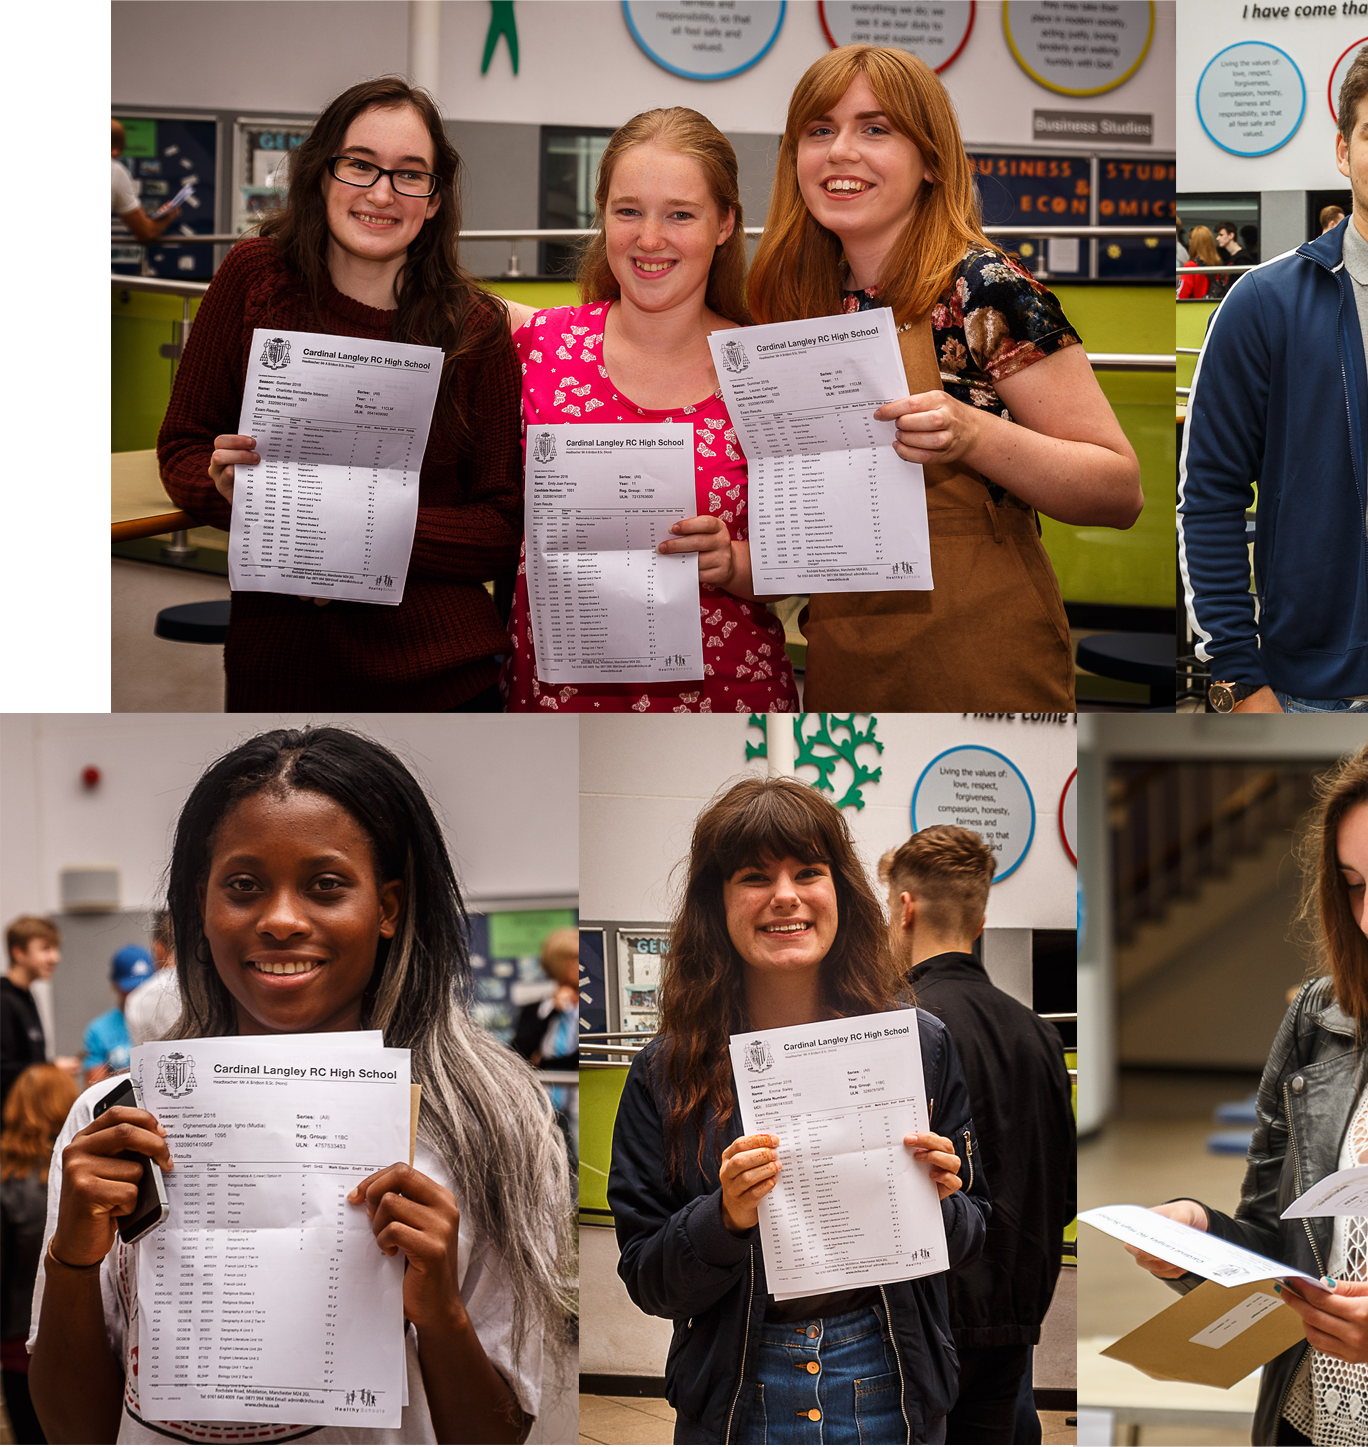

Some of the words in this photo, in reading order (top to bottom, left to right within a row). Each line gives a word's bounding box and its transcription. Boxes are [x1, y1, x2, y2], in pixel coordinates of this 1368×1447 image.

[1242, 5, 1248, 19] I
[1252, 4, 1290, 18] have
[1294, 5, 1337, 17] come
[1034, 116, 1097, 134] Business
[1100, 118, 1152, 136] Studies
[1075, 178, 1090, 196] &
[756, 341, 787, 352] Cardinal
[787, 338, 817, 348] Langley
[817, 334, 830, 343] RC
[831, 332, 850, 341] High
[850, 327, 879, 338] School
[303, 348, 337, 359] Cardinal
[338, 352, 369, 364] Langley
[370, 356, 383, 364] RC
[384, 357, 403, 367] High
[403, 359, 431, 370] School
[566, 439, 595, 447] Cardinal
[596, 439, 624, 448] Langley
[625, 439, 637, 447] RC
[639, 439, 657, 448] High
[1021, 713, 1069, 724] come
[939, 767, 960, 778] Living
[961, 768, 973, 777] the
[974, 769, 997, 778] values
[998, 769, 1008, 778] of:
[953, 780, 970, 790] love,
[971, 782, 999, 791] respect,
[955, 792, 997, 803] forgiveness,
[938, 805, 980, 815] compassion,
[981, 806, 1011, 817] honesty,
[955, 817, 983, 827] fairness
[984, 818, 997, 827] and
[995, 831, 1010, 839] that
[783, 1040, 817, 1051] Cardinal
[817, 1036, 849, 1046] Langley
[850, 1032, 863, 1041] RC
[864, 1030, 883, 1040] High
[883, 1026, 910, 1037] School
[213, 1064, 260, 1074] Cardinal
[263, 1065, 307, 1078] Langley
[310, 1067, 327, 1077] RC
[330, 1068, 355, 1079] High
[358, 1068, 397, 1079] School
[358, 1406, 386, 1414] Schools
